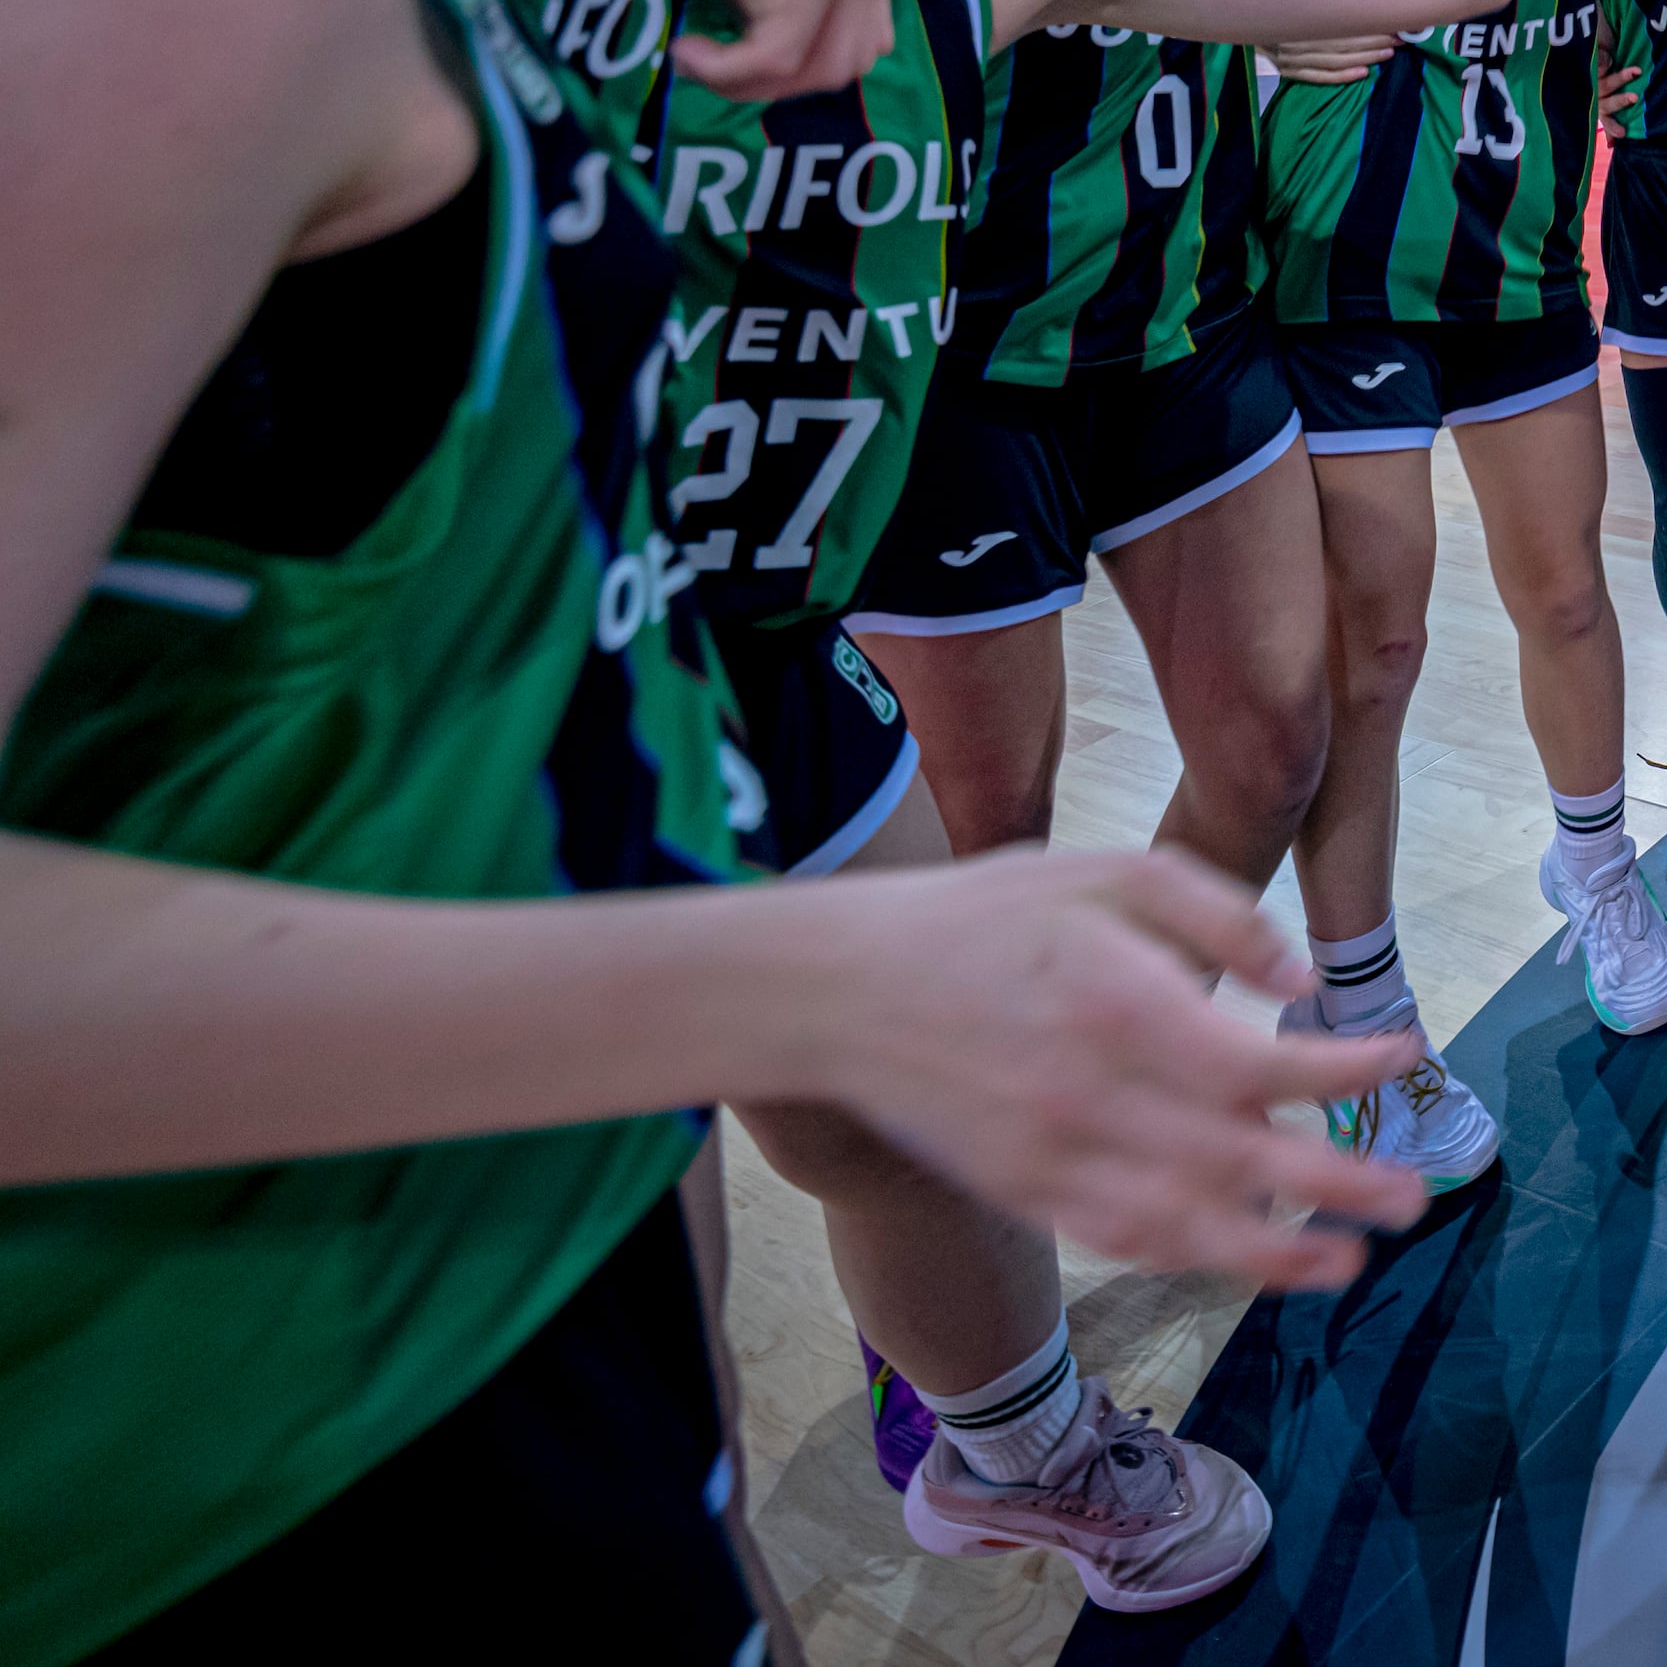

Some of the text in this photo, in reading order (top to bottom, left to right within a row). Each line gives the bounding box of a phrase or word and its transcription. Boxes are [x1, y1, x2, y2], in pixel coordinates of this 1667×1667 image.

[1135, 74, 1192, 189] 0
[1454, 63, 1526, 161] 13
[631, 138, 976, 236] RIFOLS
[669, 398, 884, 570] 27
